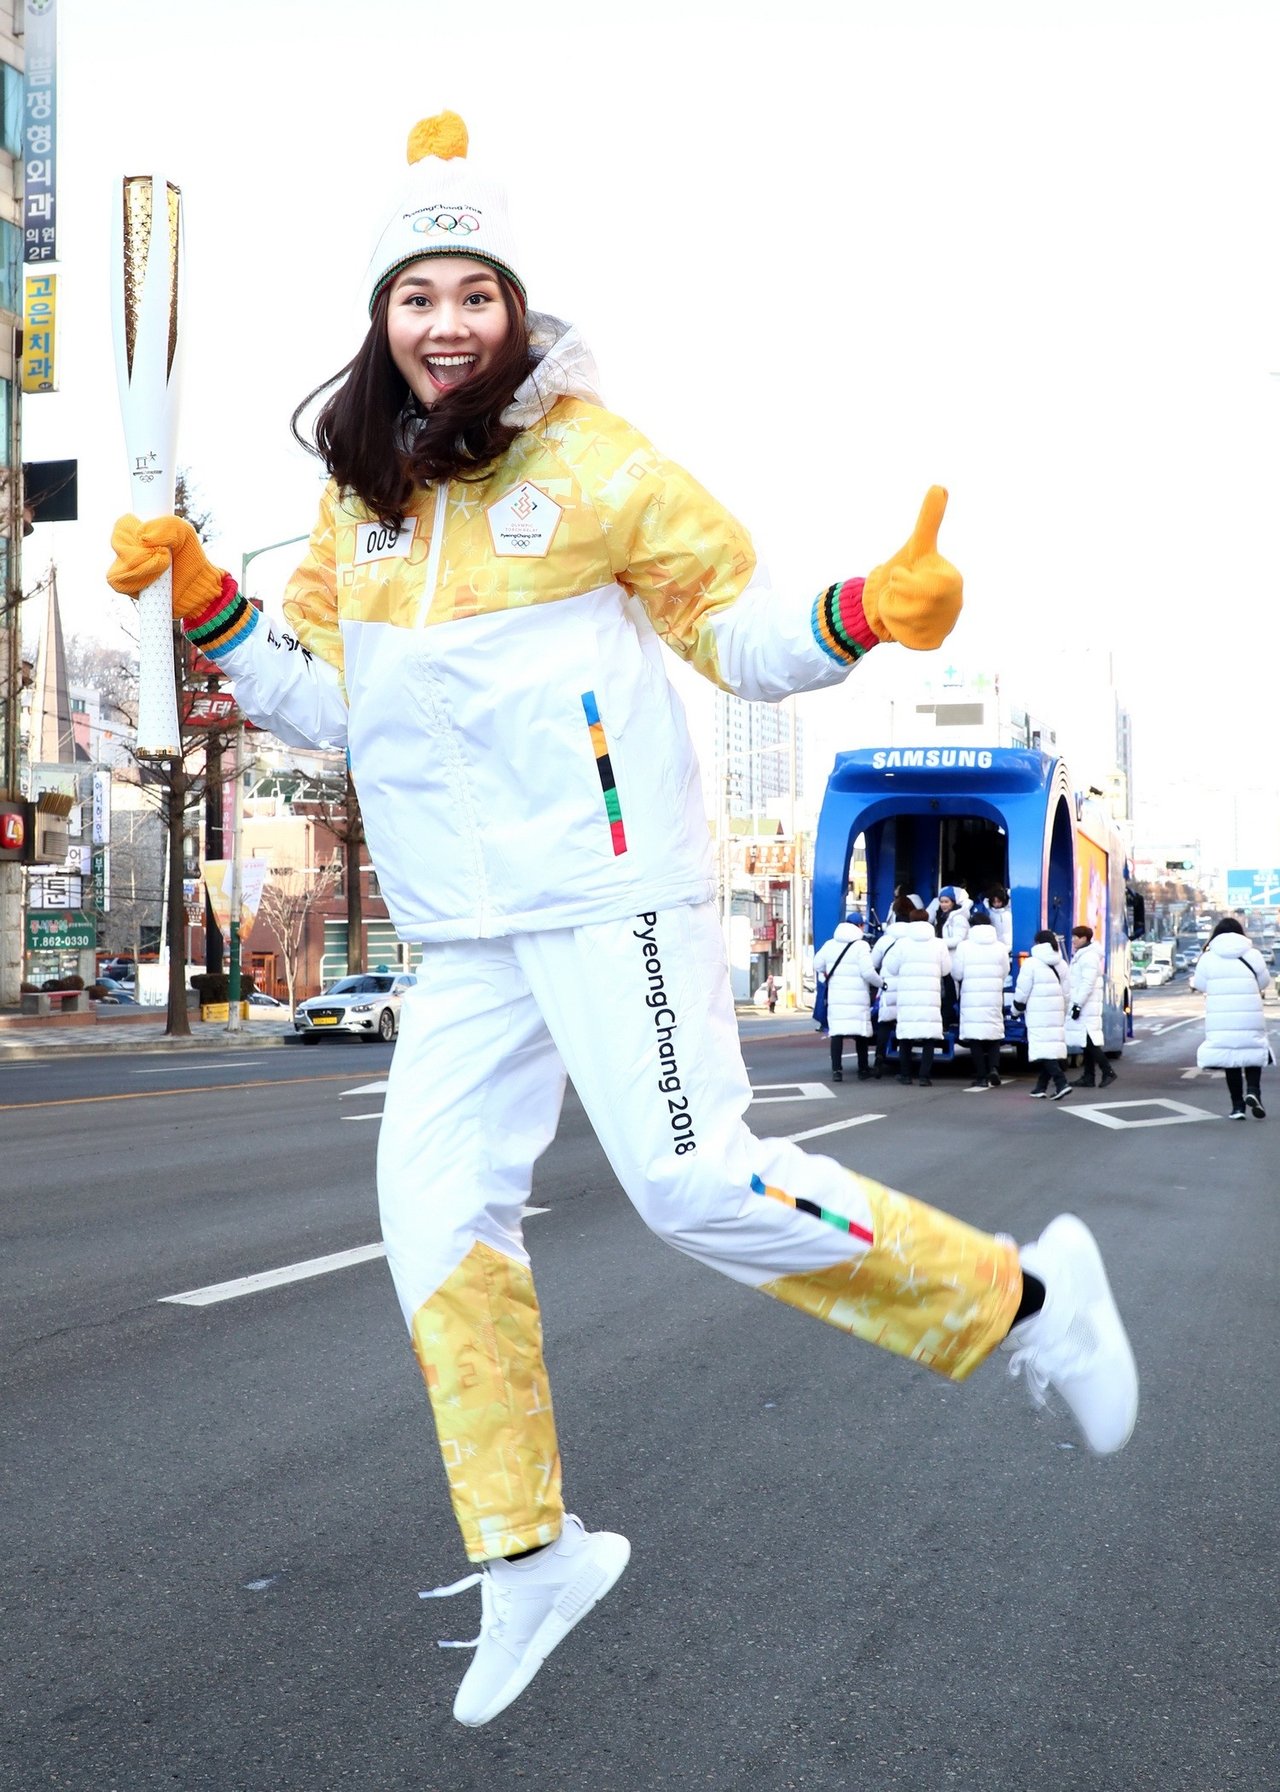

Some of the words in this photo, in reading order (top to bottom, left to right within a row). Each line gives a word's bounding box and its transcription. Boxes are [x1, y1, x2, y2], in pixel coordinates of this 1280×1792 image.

[26, 227, 55, 243] 의원
[29, 246, 52, 260] 2F
[28, 277, 52, 378] 고은치과
[367, 528, 400, 553] 009
[872, 750, 992, 770] SAMSUNG
[32, 936, 89, 947] T.862-0330
[633, 911, 681, 1093] PyeongChang
[668, 1095, 697, 1156] 2018
